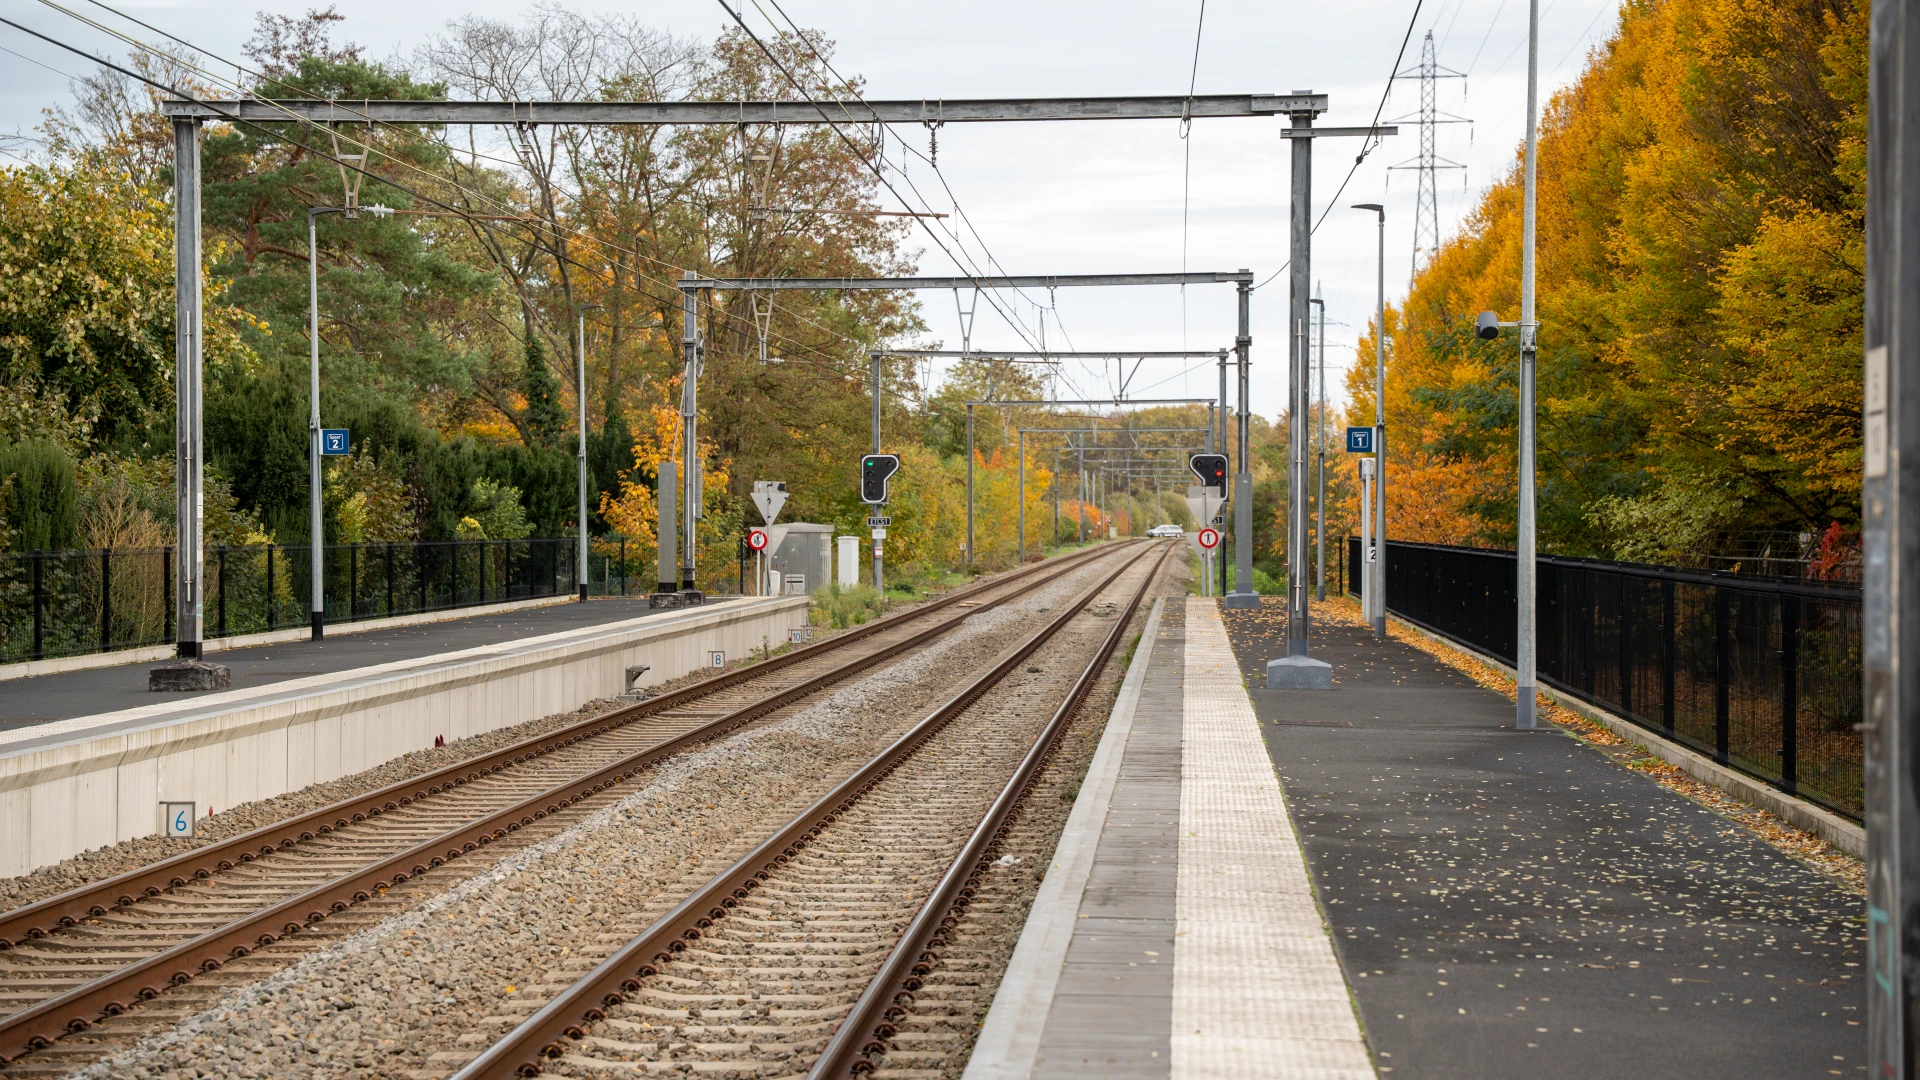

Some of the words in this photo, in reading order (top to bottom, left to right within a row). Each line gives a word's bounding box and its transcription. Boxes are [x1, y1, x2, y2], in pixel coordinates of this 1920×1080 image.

[332, 439, 339, 449] 2
[1357, 437, 1362, 447] 1
[792, 632, 801, 641] 10
[715, 654, 721, 665] 8
[175, 810, 187, 832] 6
